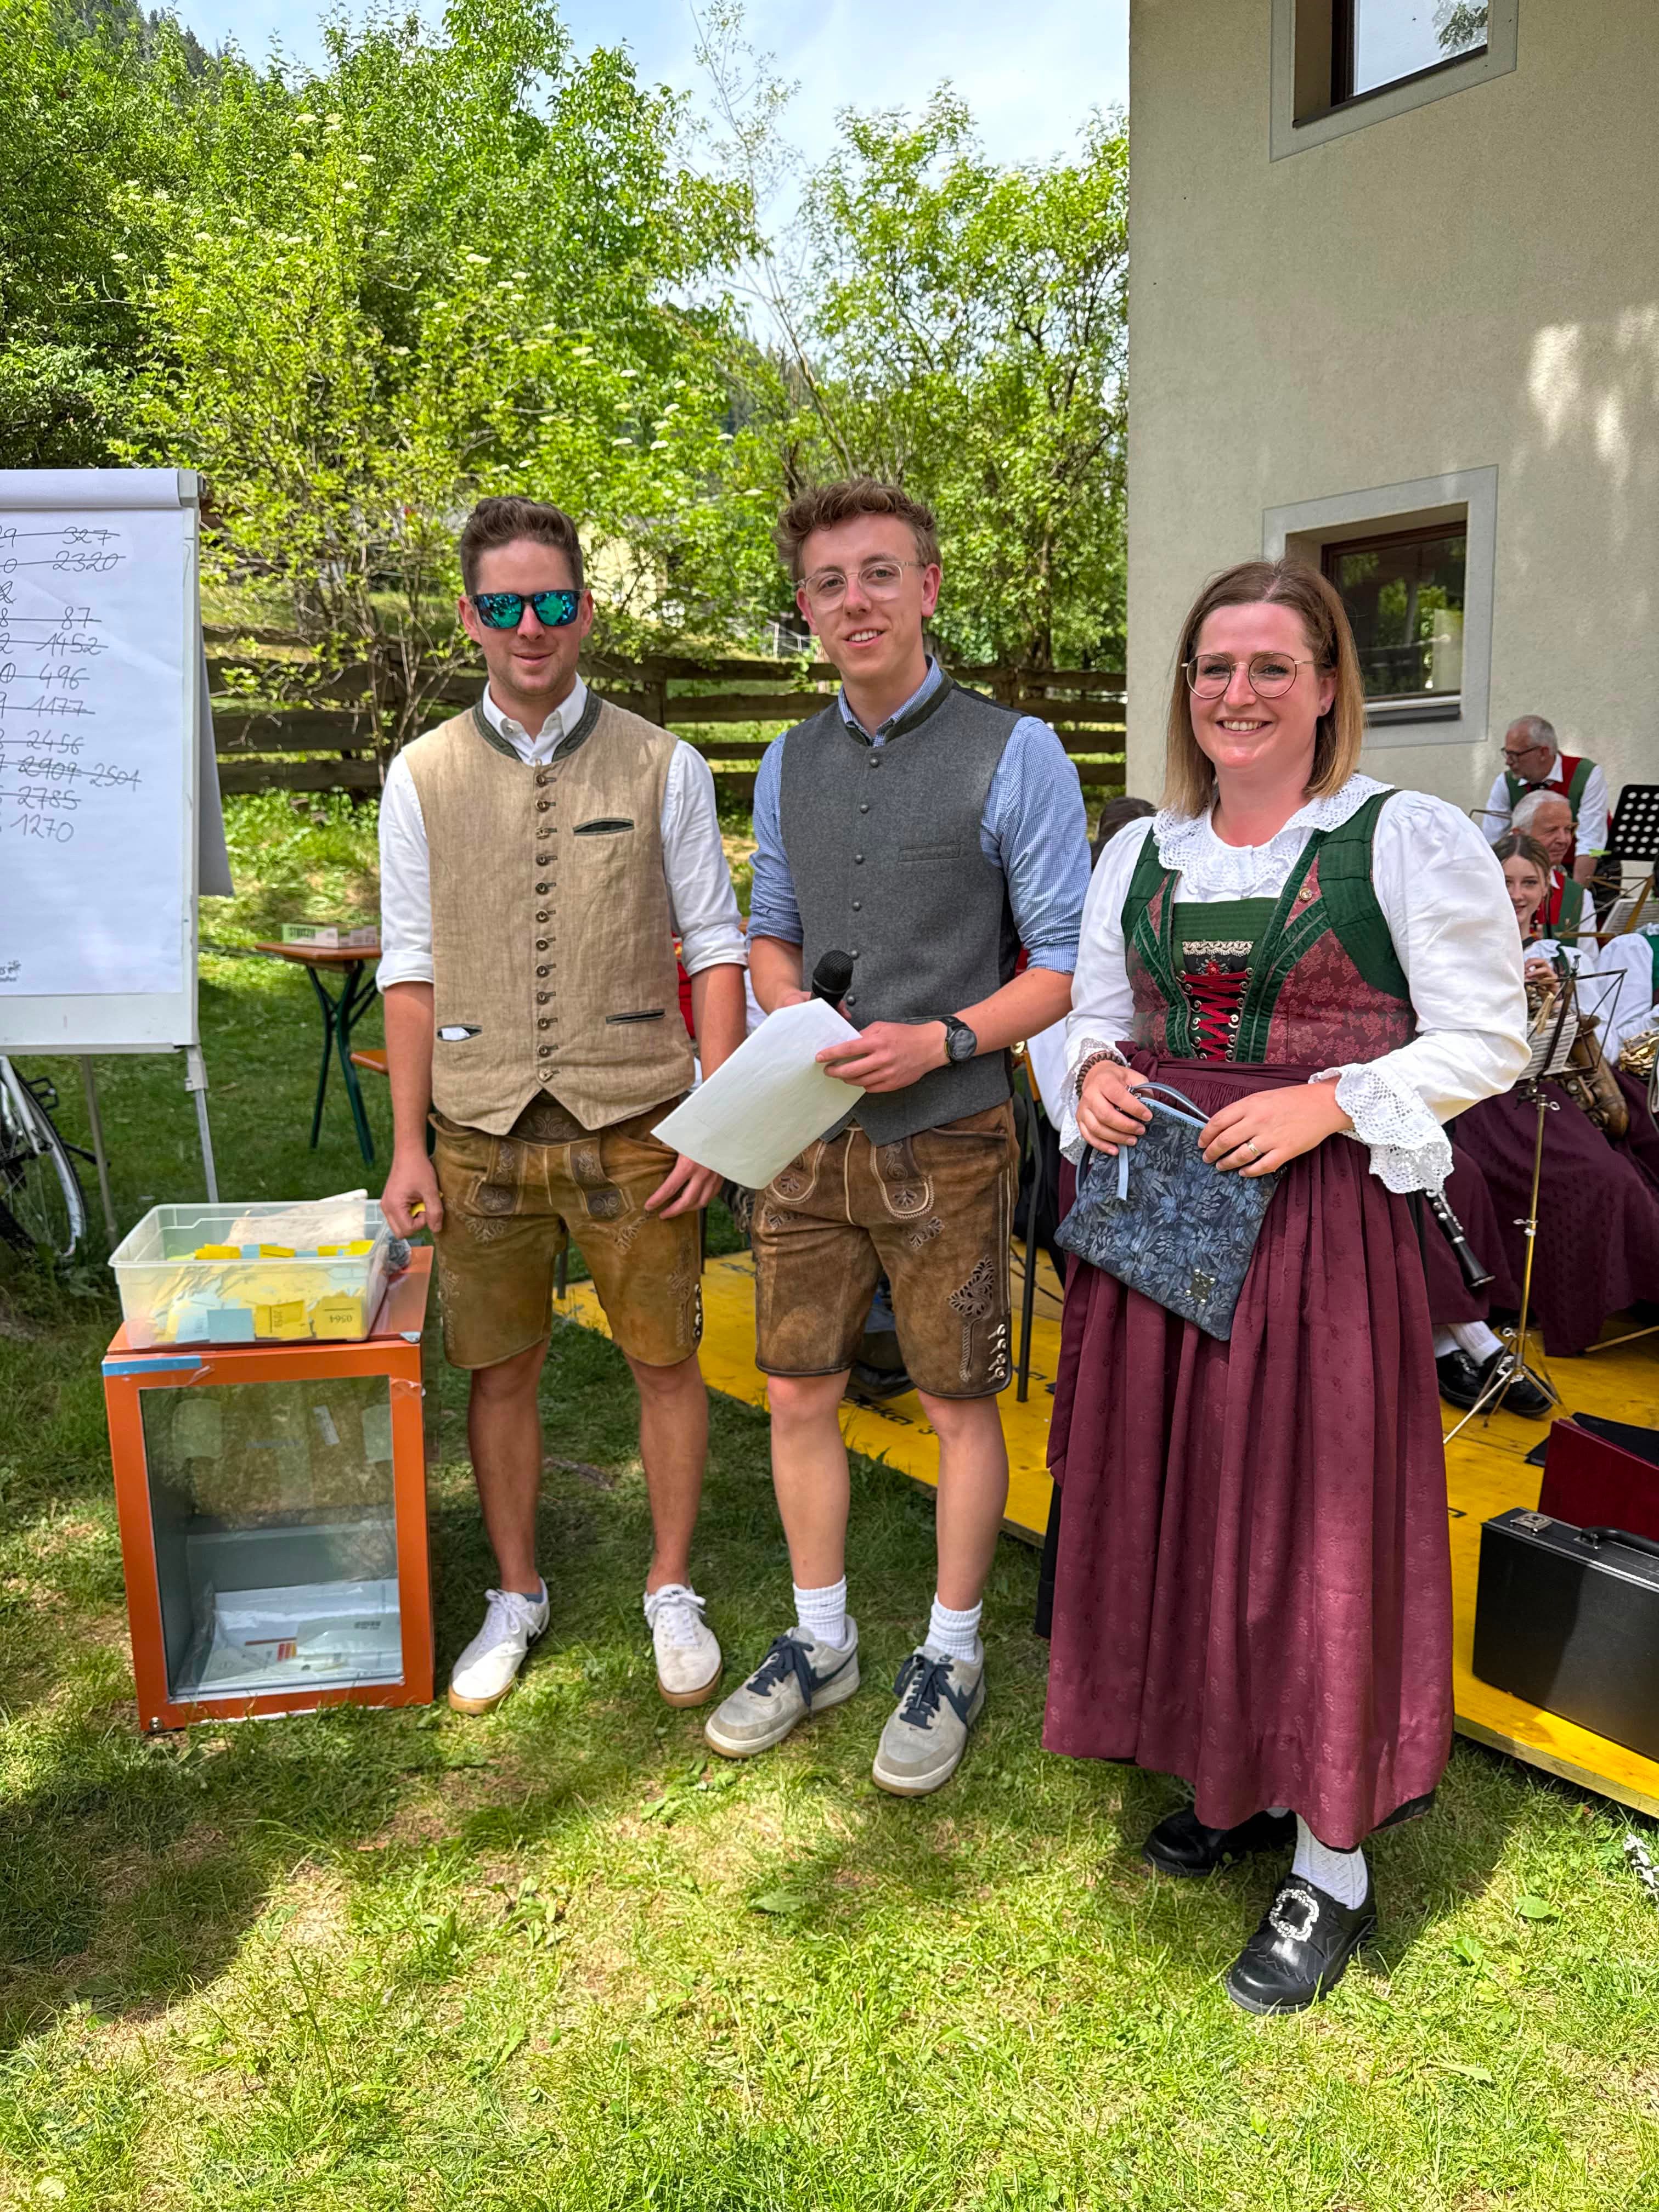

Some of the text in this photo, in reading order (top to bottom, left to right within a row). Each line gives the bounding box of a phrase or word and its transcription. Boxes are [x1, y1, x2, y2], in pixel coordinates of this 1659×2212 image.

[0, 525, 113, 548] 9 327
[53, 551, 119, 572] 2320
[61, 606, 93, 630] 87
[36, 632, 101, 656] 1452
[40, 663, 87, 690] 496
[27, 695, 87, 718] 1177
[27, 730, 84, 755] 2456
[90, 763, 139, 792] 2501
[18, 786, 78, 810] 2785
[10, 814, 75, 843] 1270
